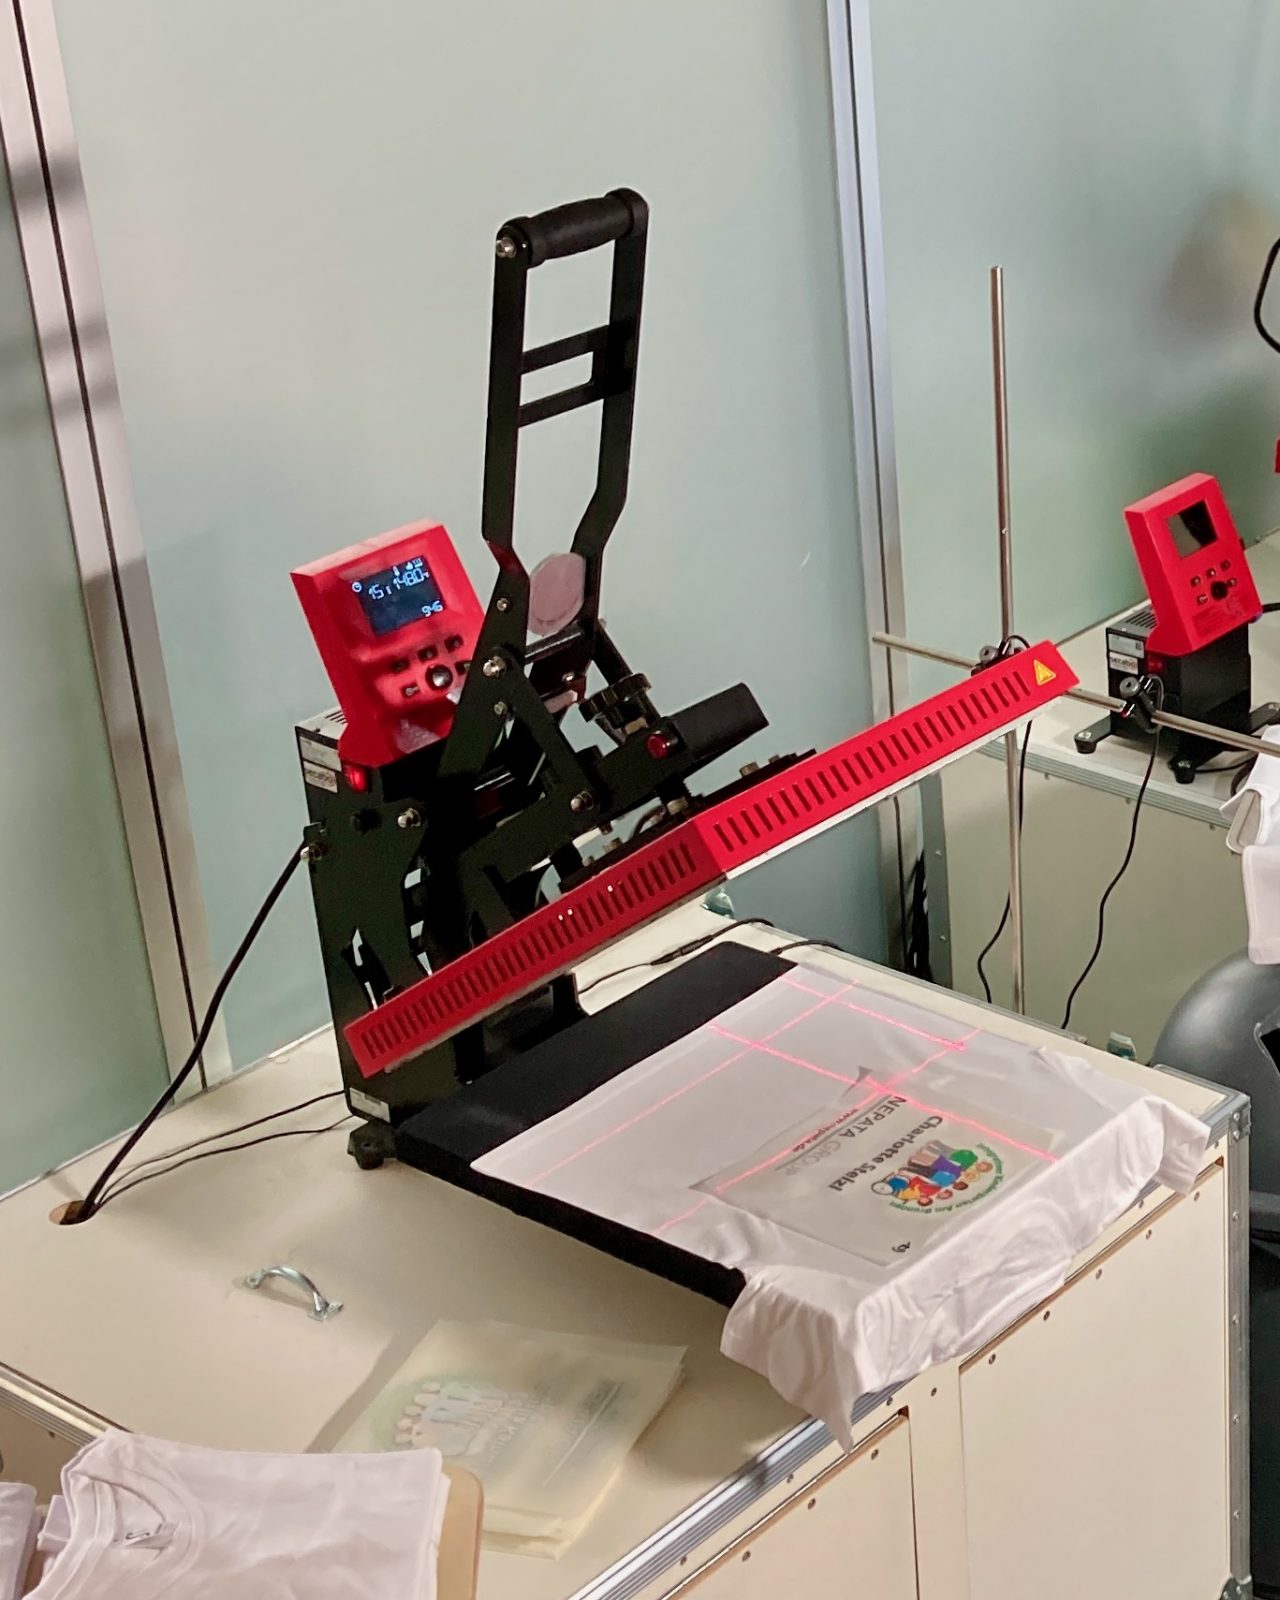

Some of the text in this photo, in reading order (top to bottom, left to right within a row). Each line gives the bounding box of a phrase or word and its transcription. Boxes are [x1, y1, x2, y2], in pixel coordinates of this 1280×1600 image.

[785, 1095, 907, 1176] NEPATA GROUP
[872, 1115, 943, 1164] Charlotte
